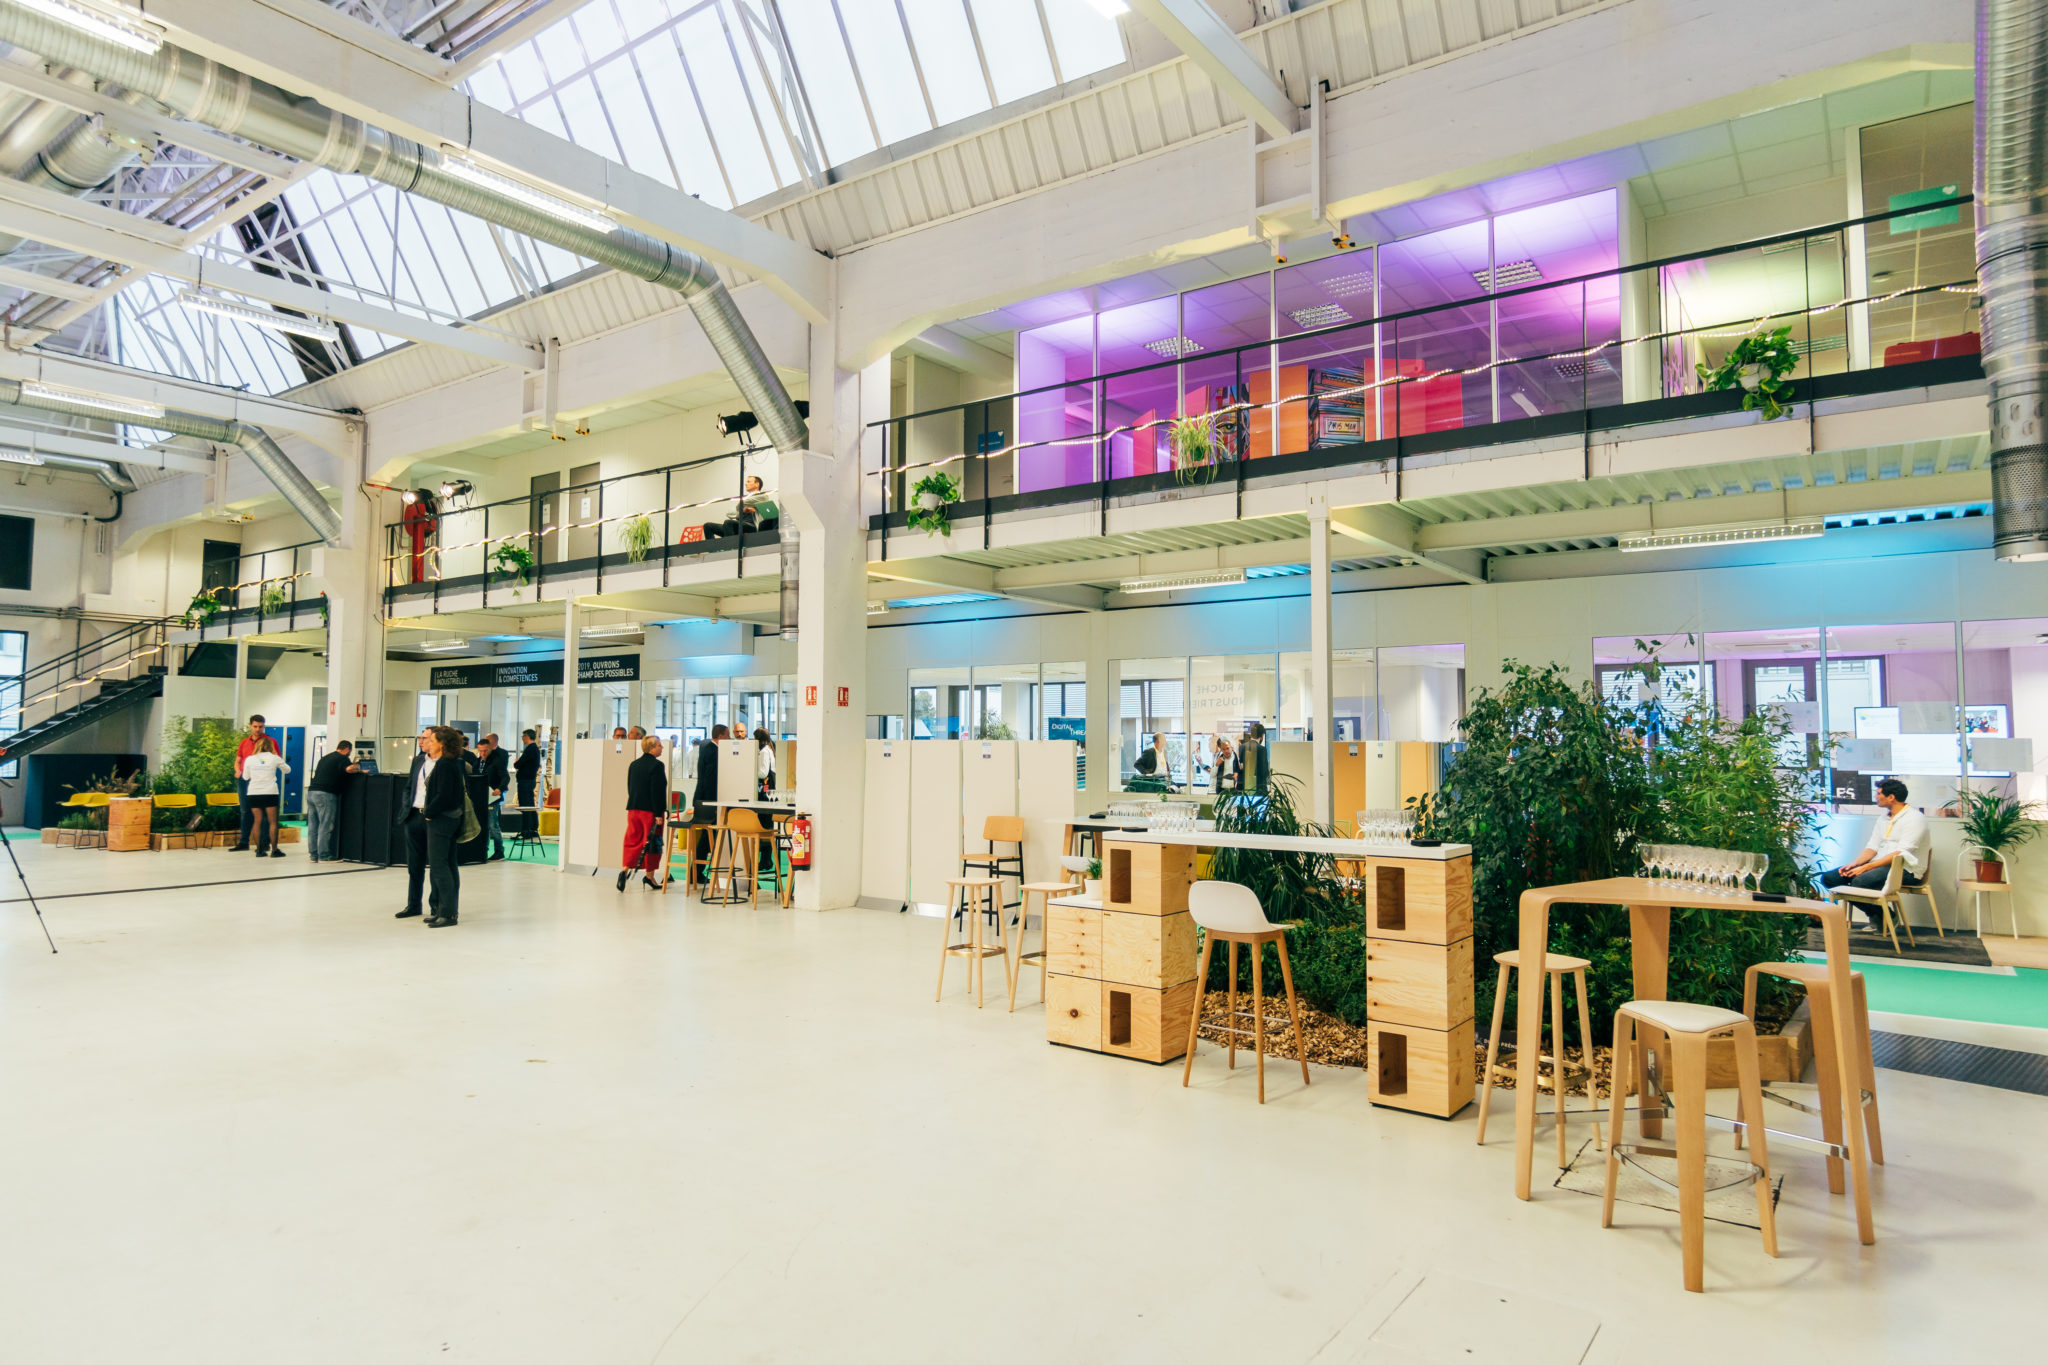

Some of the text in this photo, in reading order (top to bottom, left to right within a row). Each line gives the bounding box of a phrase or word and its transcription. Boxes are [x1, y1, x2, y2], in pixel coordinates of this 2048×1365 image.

[592, 660, 620, 670] OUVRONS
[498, 666, 528, 675] INNOVATION
[605, 668, 634, 678] POSSIBLES
